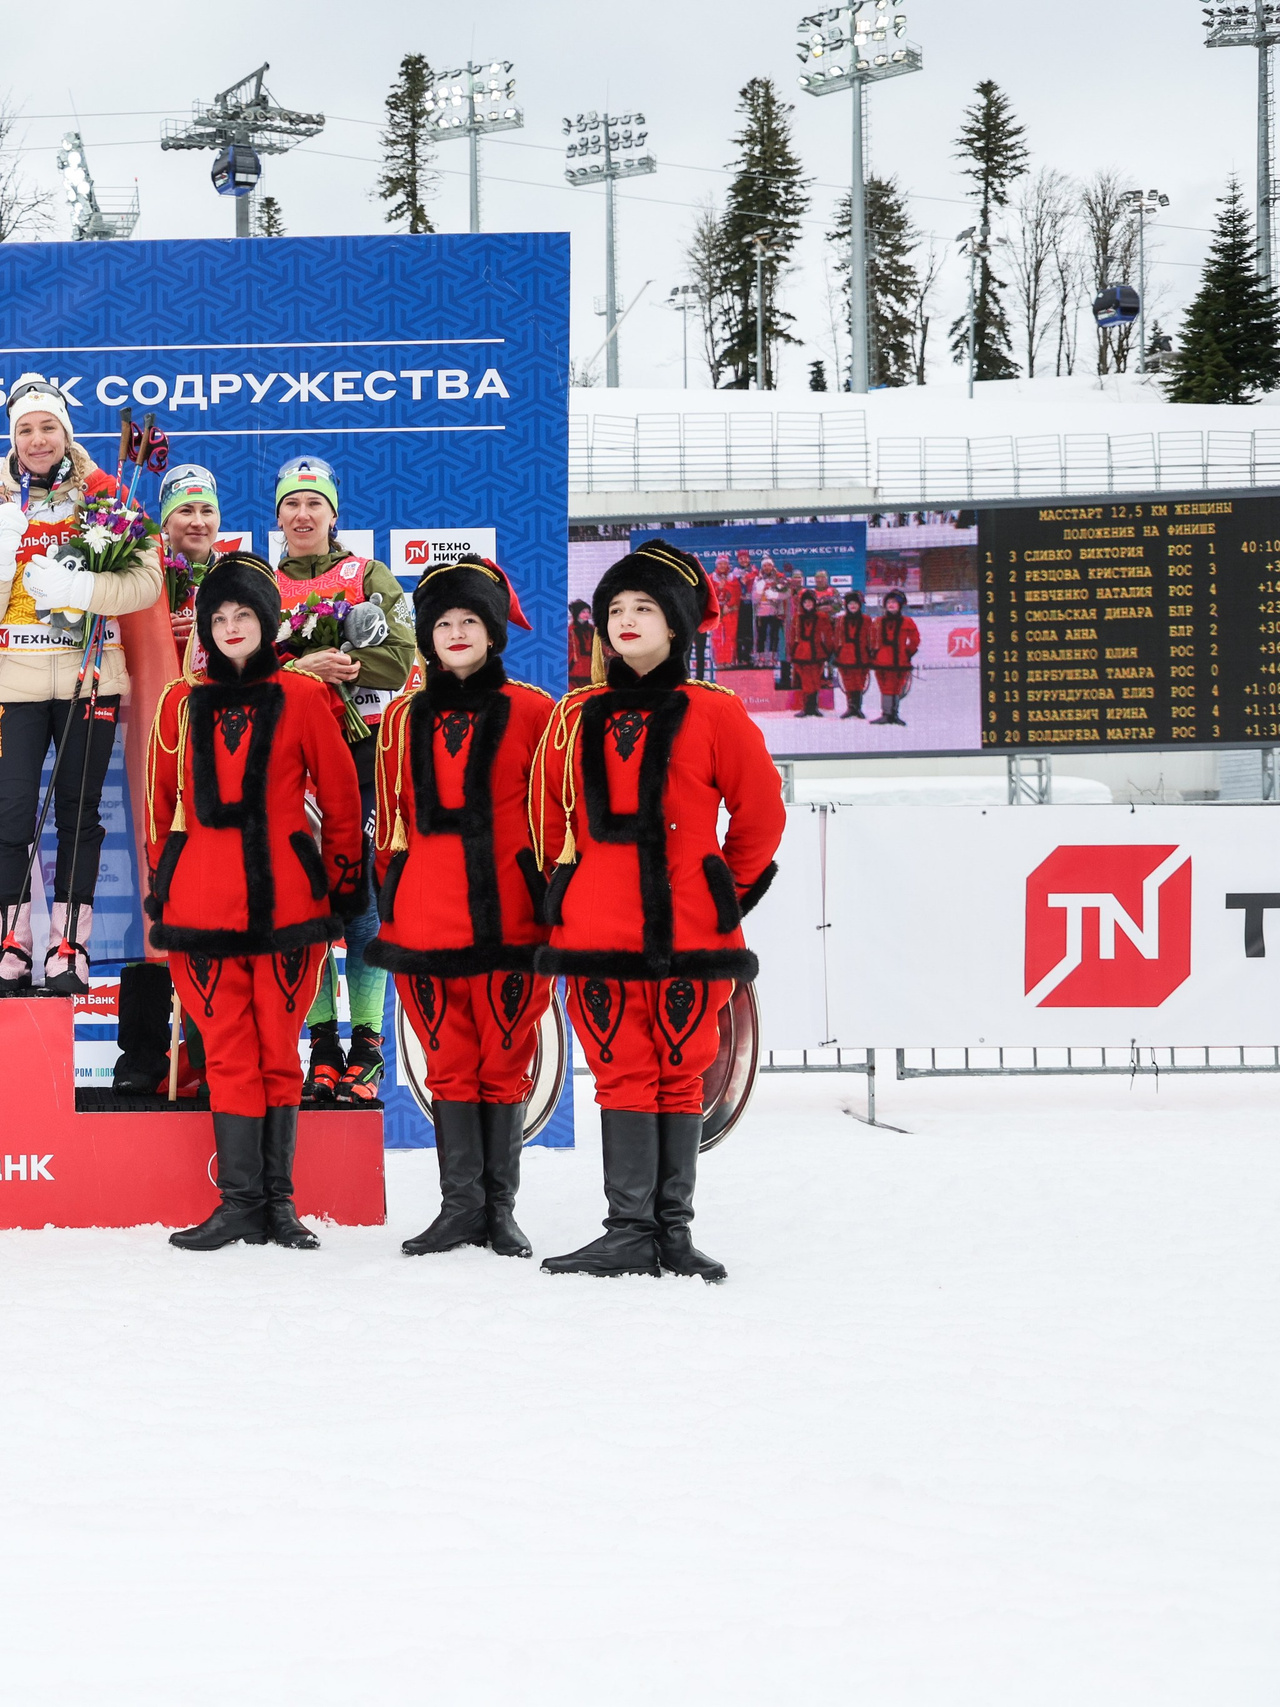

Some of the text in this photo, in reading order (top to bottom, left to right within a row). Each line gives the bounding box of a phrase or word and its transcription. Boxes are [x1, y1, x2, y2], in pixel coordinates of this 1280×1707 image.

[96, 368, 510, 411] СОДРУЖЕСТВА
[1039, 507, 1103, 521] МАССТАРТ
[1151, 504, 1168, 517] КМ
[1174, 502, 1233, 516] ЖЕНЩИНЫ
[20, 532, 58, 548] льфа
[1063, 522, 1216, 540] ПОЛОЖЕНИЕ НА ФИНИШЕ
[432, 542, 471, 551] ТЕХНО
[773, 546, 854, 556] СОДРУЖЕСТВА
[985, 551, 993, 564] 1
[1009, 550, 1017, 563] 3
[1024, 548, 1073, 562] СЛИВКО
[1079, 546, 1144, 560] ВИКТОРИЯ
[1168, 543, 1192, 557] РОС
[1209, 542, 1216, 555] 1
[433, 552, 464, 561] НИКО
[986, 571, 994, 584] 2
[1009, 570, 1017, 583] 2
[1025, 568, 1081, 582] РЕЗЦОВА
[1088, 565, 1153, 580] КРИСТИНА
[1168, 564, 1193, 577] РОС
[1209, 562, 1217, 575] 3
[986, 591, 995, 604] 3
[1010, 590, 1017, 603] 1
[1025, 588, 1089, 602] ШЕВЧЕНКО
[1096, 586, 1153, 600] НАТАЛИЯ
[1168, 584, 1193, 597] РОС
[1209, 583, 1217, 595] 4
[986, 611, 995, 624] 4
[1010, 610, 1018, 623] 5
[1025, 608, 1098, 623] СМОЛЬСКАЯ
[1104, 606, 1154, 621] ДИНАРА
[1168, 604, 1194, 617] БЛР
[1209, 603, 1217, 616] 2
[986, 630, 995, 644] 5
[1010, 630, 1019, 643] 6
[1025, 629, 1059, 642] СОЛА
[1064, 628, 1098, 641] АННА
[1169, 625, 1194, 638] БЛР
[1210, 623, 1218, 636] 2
[988, 650, 996, 663] 6
[1003, 650, 1019, 663] 12
[1026, 648, 1098, 662] КОВАЛЕНКО
[1105, 646, 1139, 660] ЮЛИЯ
[1169, 645, 1195, 658] РОС
[1210, 643, 1218, 656] 2
[988, 670, 996, 682] 7
[1004, 670, 1019, 683] 10
[1026, 668, 1099, 683] ДЕРБУШЕВА
[1105, 666, 1156, 680] ТАМАРА
[1170, 665, 1195, 678] РОС
[1211, 663, 1219, 676] 0
[988, 690, 996, 703] 8
[1004, 689, 1020, 703] 13
[1027, 687, 1116, 702] БУРУНДУКОВА
[1122, 686, 1155, 699] ЕЛИЗ
[1170, 685, 1196, 698] РОС
[1211, 684, 1219, 697] 4
[989, 710, 997, 723] 9
[1012, 709, 1020, 723] 8
[1028, 708, 1100, 722] КАЗАКЕВИЧ
[1106, 707, 1148, 720] ИРИНА
[1171, 705, 1196, 718] РОС
[1212, 704, 1220, 717] 4
[982, 730, 997, 744] 10
[1004, 730, 1021, 743] 20
[1028, 728, 1101, 743] БОЛДЫРЕВА
[1106, 727, 1156, 740] МАРГАР
[1171, 726, 1196, 739] РОС
[1213, 724, 1221, 738] 3
[88, 994, 115, 1005] Банк
[95, 1067, 115, 1077] ПОЛЯ
